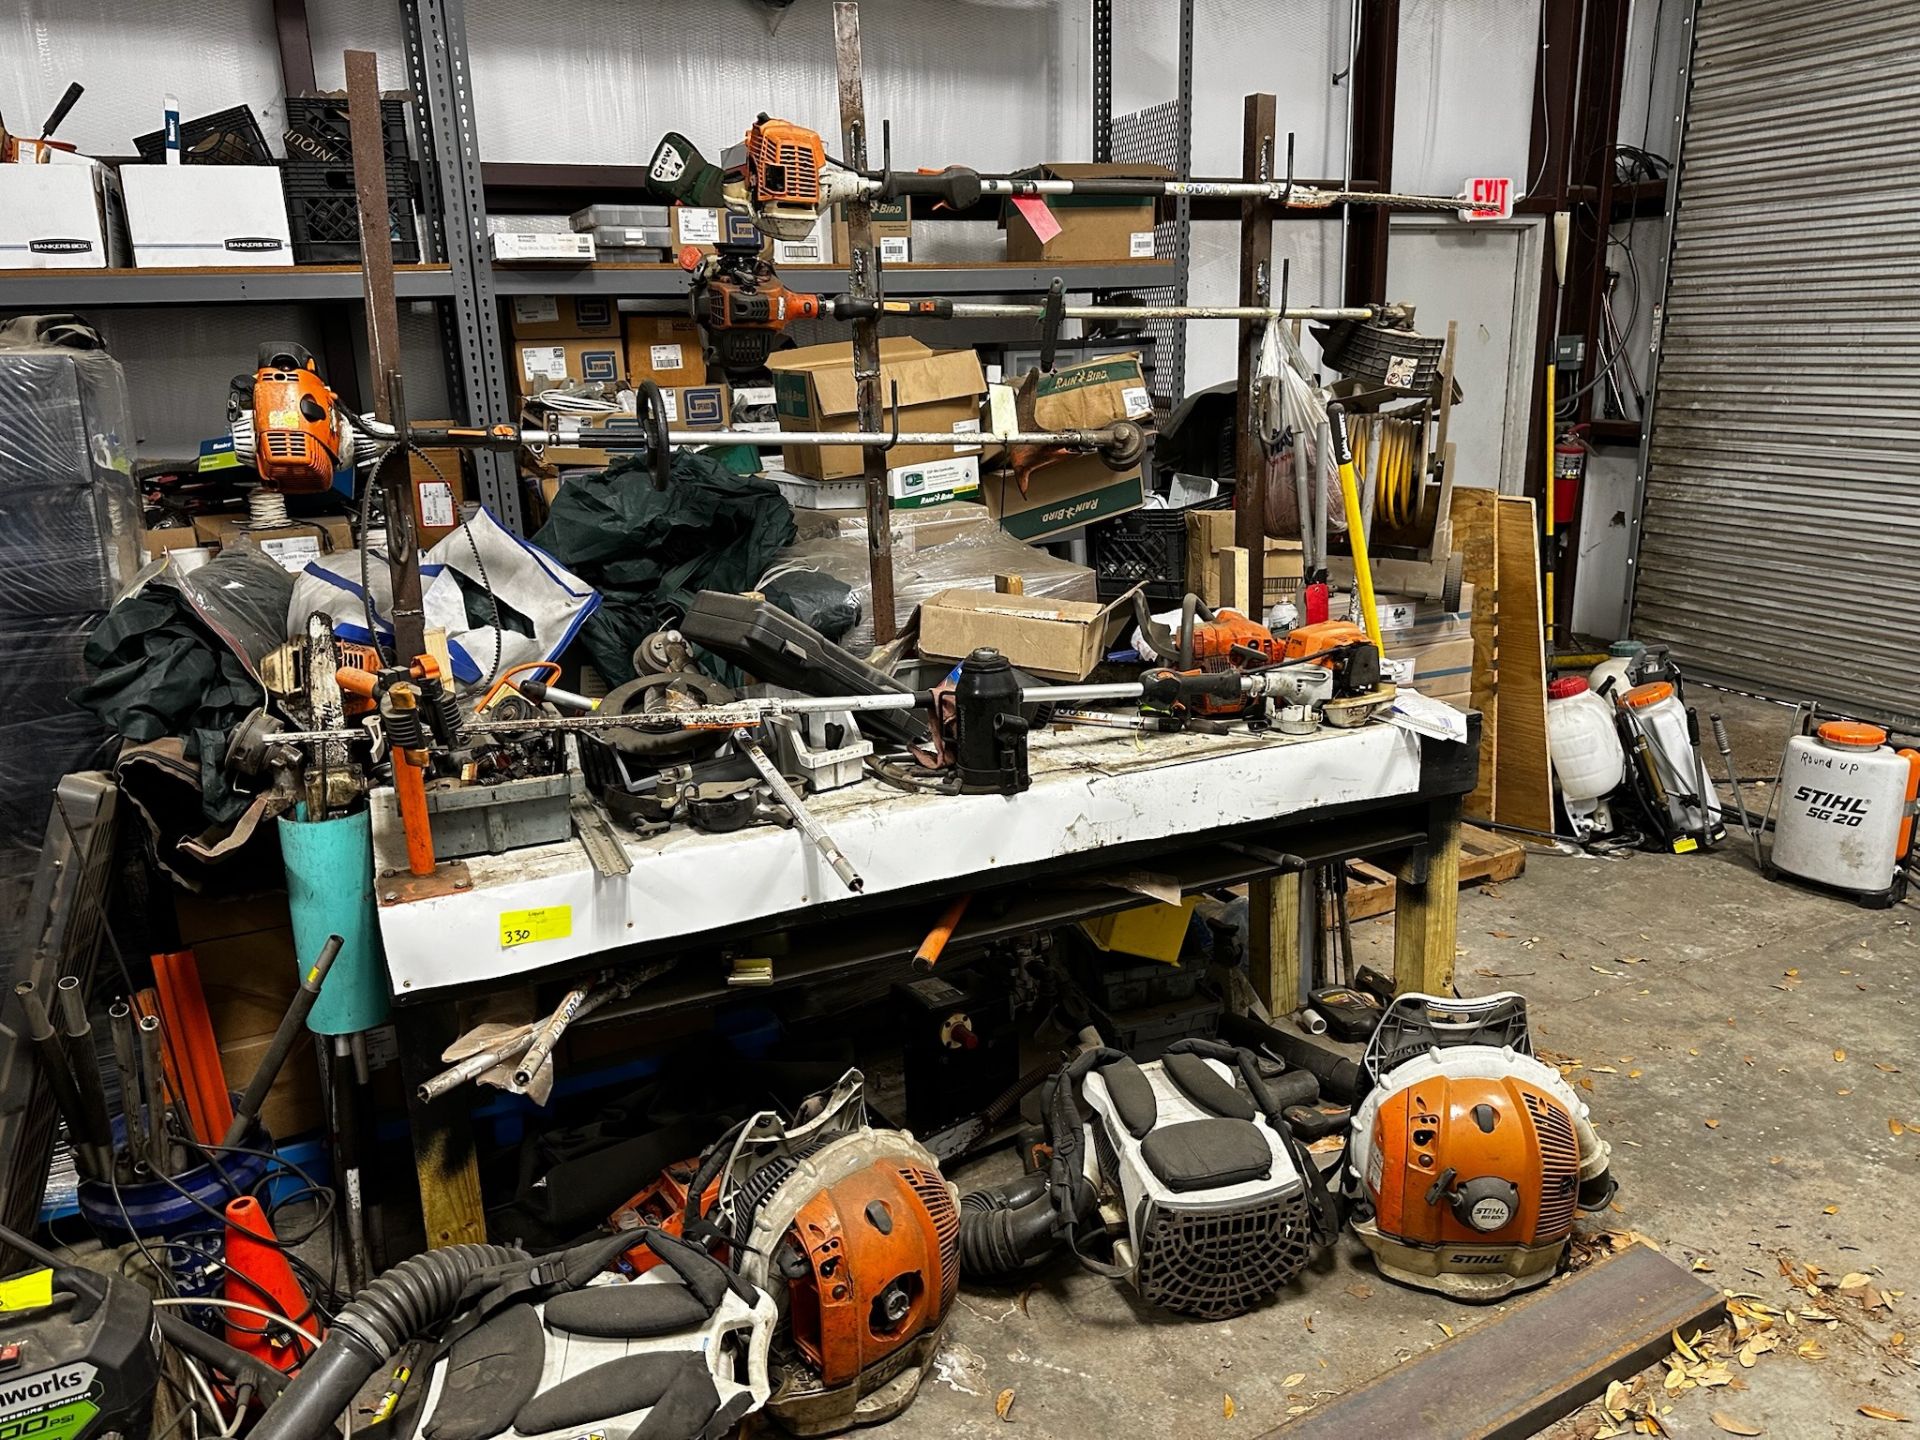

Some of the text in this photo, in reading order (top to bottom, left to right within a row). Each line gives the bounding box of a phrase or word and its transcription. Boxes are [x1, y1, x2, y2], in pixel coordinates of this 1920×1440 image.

[653, 147, 673, 178] Crew
[879, 204, 902, 214] BIRD
[1054, 370, 1107, 389] RAIN BIRD
[920, 493, 955, 505] RAIN BIRD
[1042, 498, 1099, 522] RAIN BIRD
[1801, 752, 1859, 776] Round up
[1794, 786, 1868, 815] STIHL
[1806, 807, 1863, 827] SG 20
[504, 929, 530, 944] 330
[1450, 1254, 1504, 1264] STIHL
[0, 1392, 92, 1424] ESSURE WASHER
[50, 1414, 74, 1428] PSI
